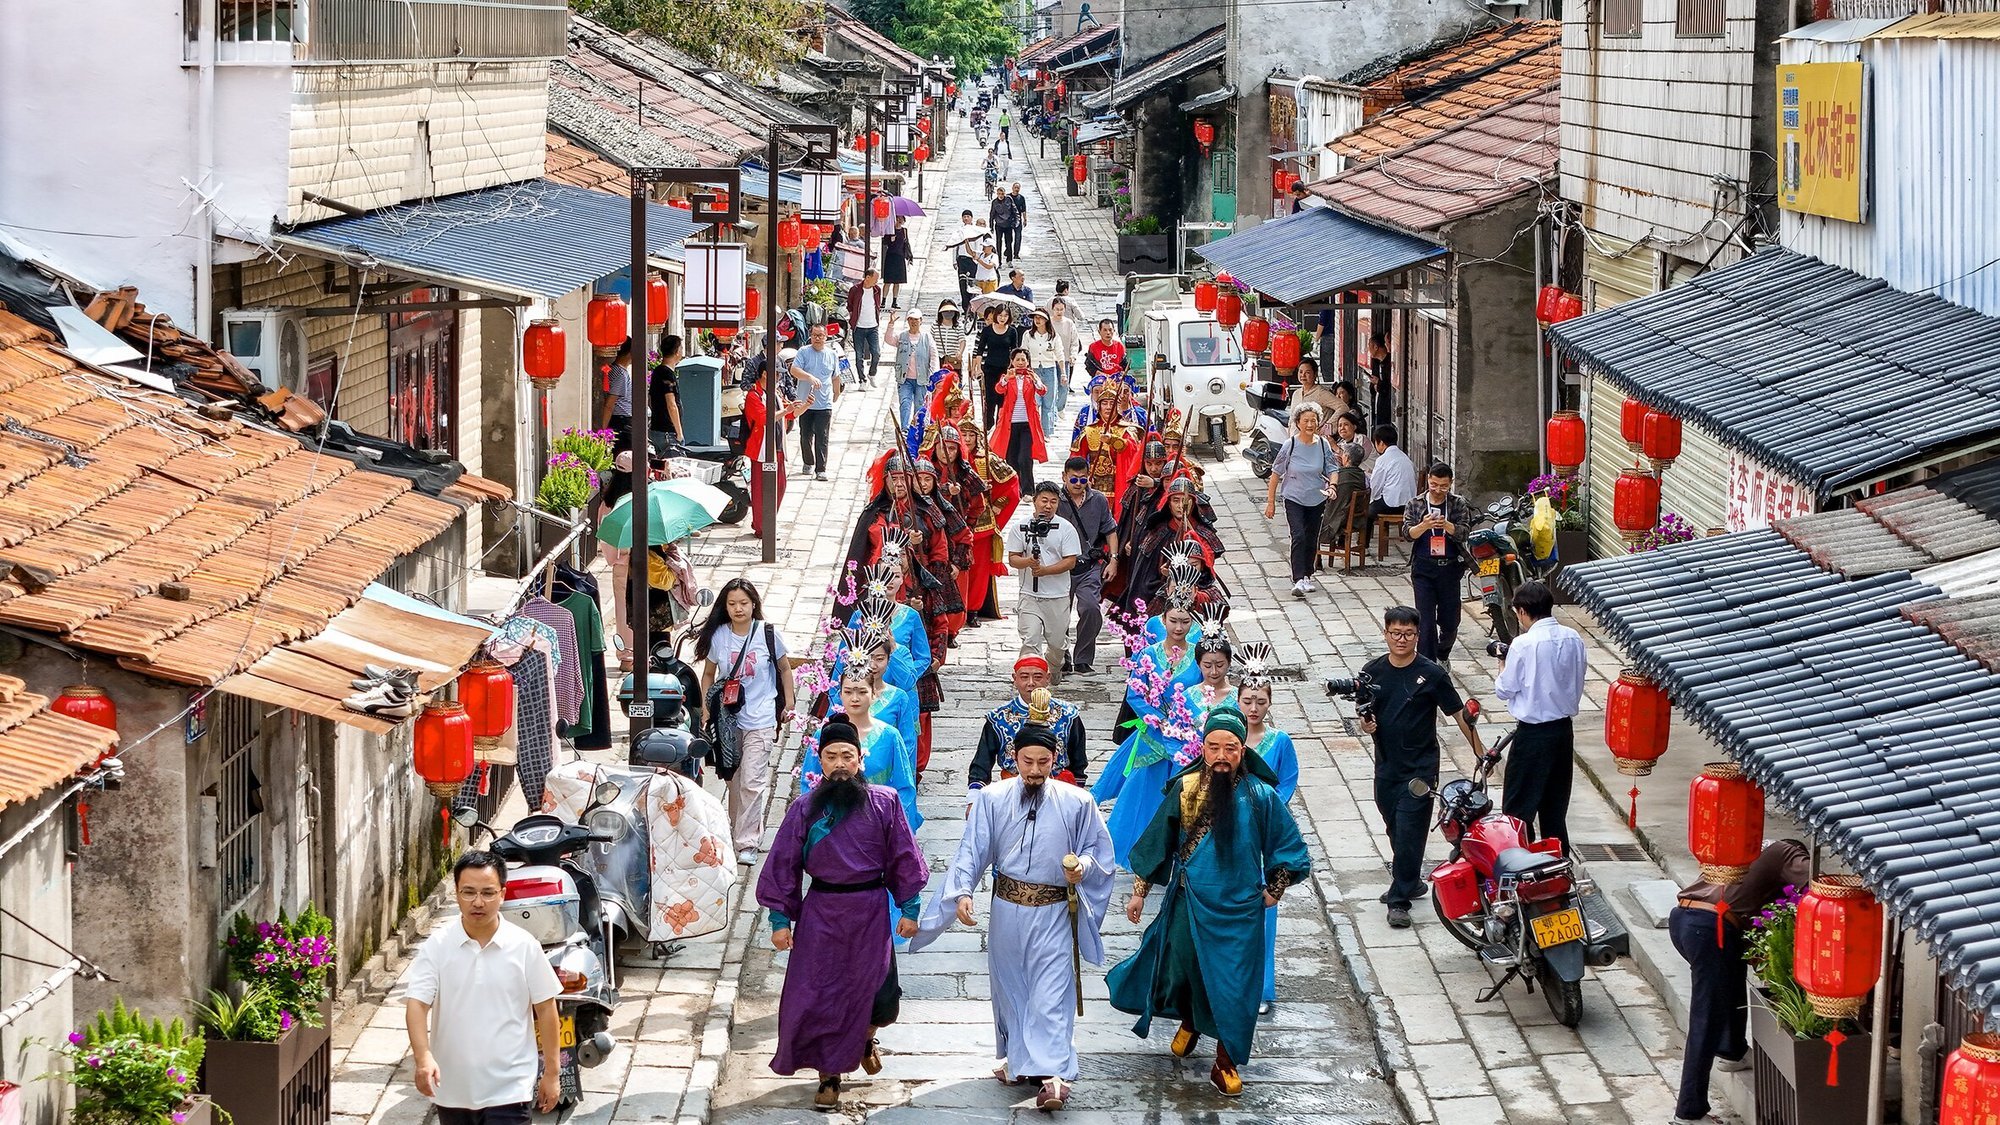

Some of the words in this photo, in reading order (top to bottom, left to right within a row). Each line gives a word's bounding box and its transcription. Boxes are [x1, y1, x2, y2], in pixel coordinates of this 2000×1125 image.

[1804, 101, 1857, 181] 北林超市
[1538, 923, 1582, 947] T2A00
